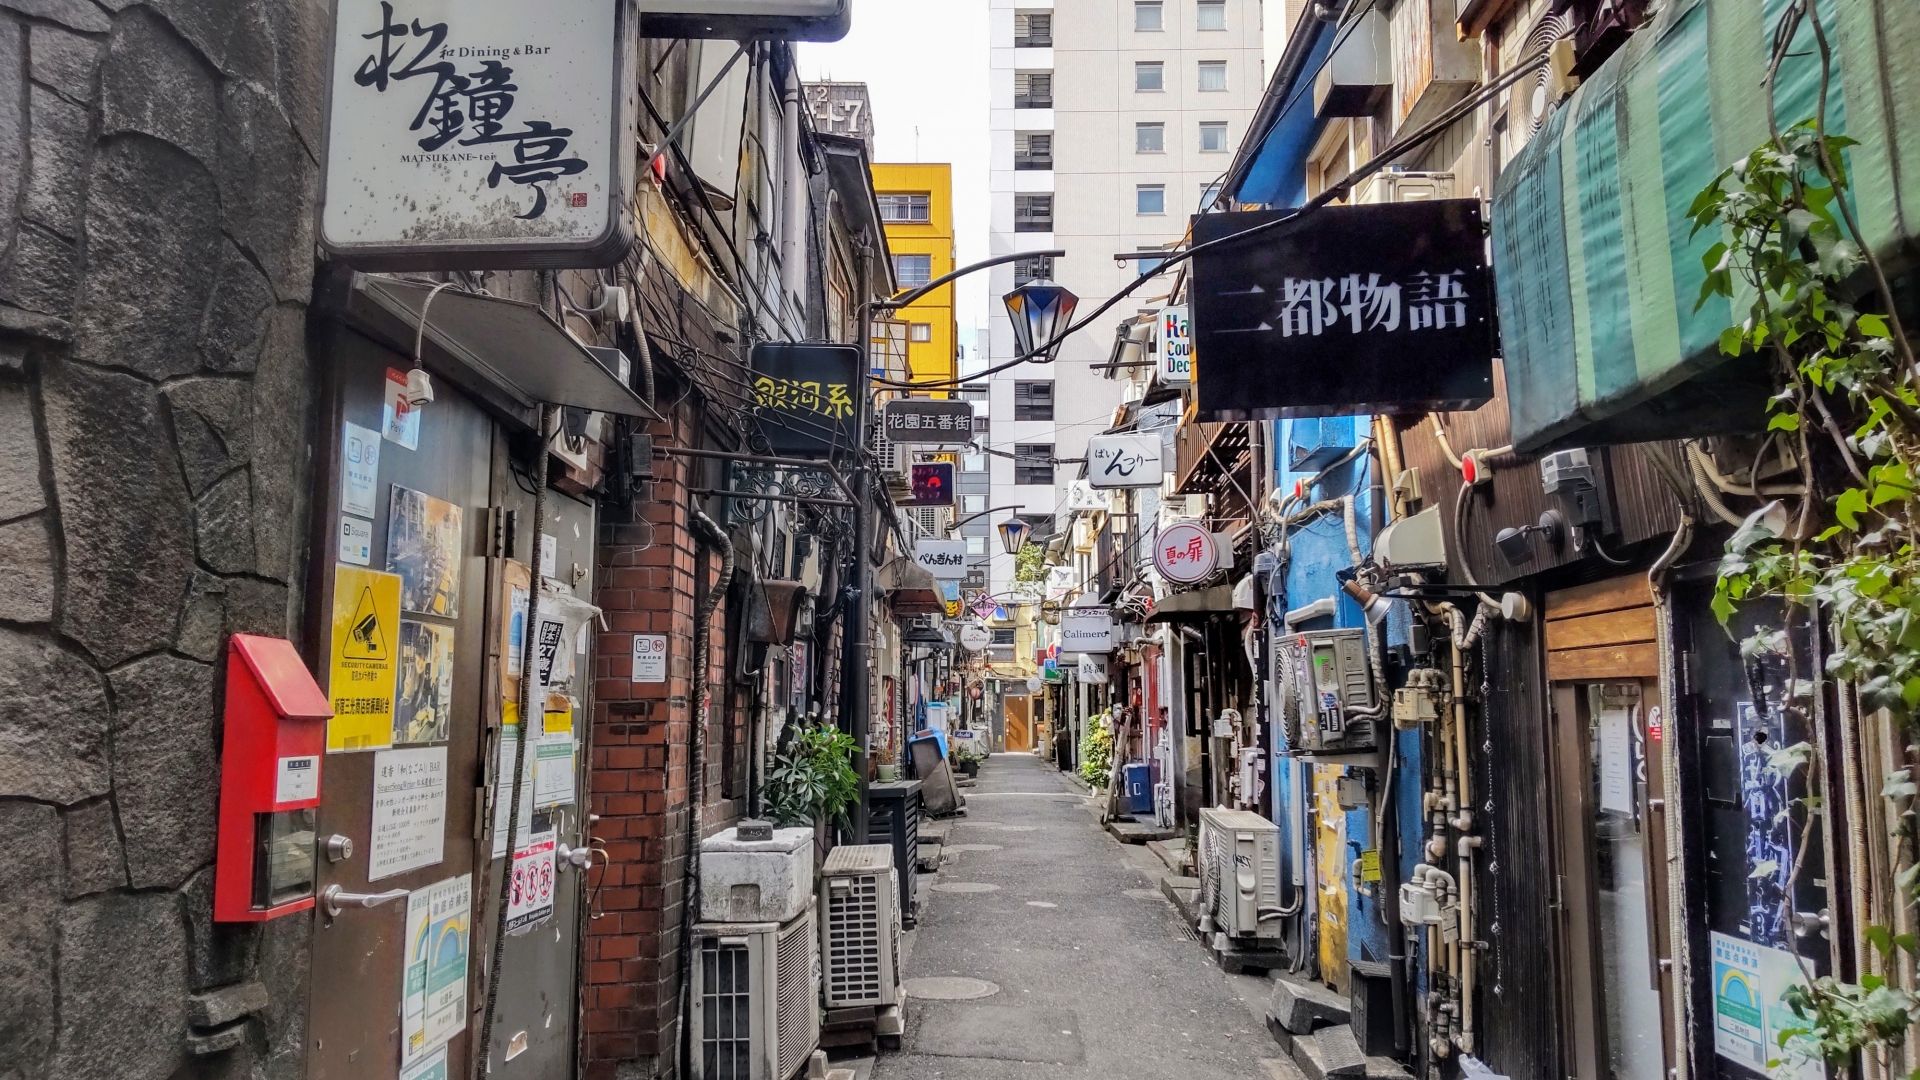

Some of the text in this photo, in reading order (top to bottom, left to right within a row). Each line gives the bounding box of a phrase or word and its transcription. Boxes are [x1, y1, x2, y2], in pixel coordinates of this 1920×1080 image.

[459, 46, 510, 60] Dining
[513, 47, 521, 56] &
[524, 44, 551, 55] Bar
[1212, 268, 1470, 338] 二都物語
[752, 377, 855, 419] 銀河系
[887, 412, 971, 432] 花園五番街
[351, 526, 369, 539] Square
[918, 552, 964, 566] ぺんぎん村
[1165, 536, 1203, 567] 夏の扉
[1063, 630, 1106, 639] Calimero
